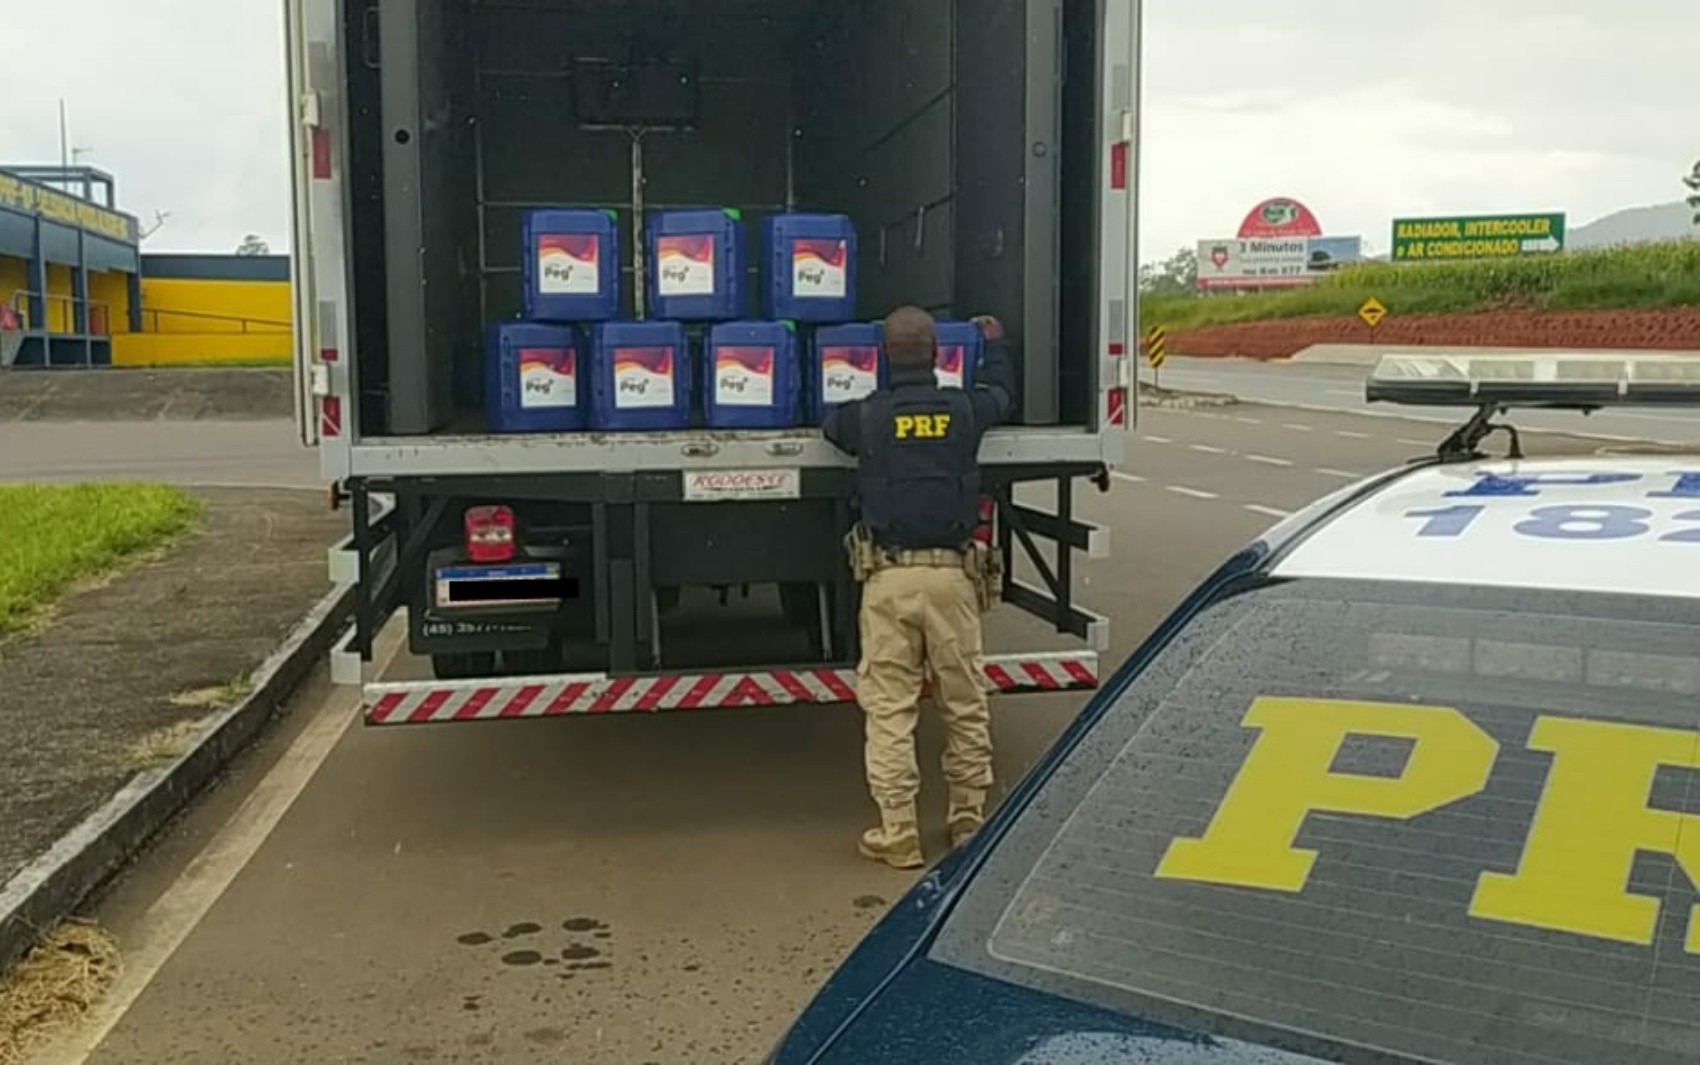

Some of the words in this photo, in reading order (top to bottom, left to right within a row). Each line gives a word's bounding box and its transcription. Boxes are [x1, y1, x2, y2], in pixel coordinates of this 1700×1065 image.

[1465, 219, 1550, 235] INTERCOOLER
[1250, 241, 1304, 252] Minutos
[1407, 242, 1424, 257] AR
[1426, 239, 1519, 257] CONDICIONADO
[895, 414, 950, 438] PRF
